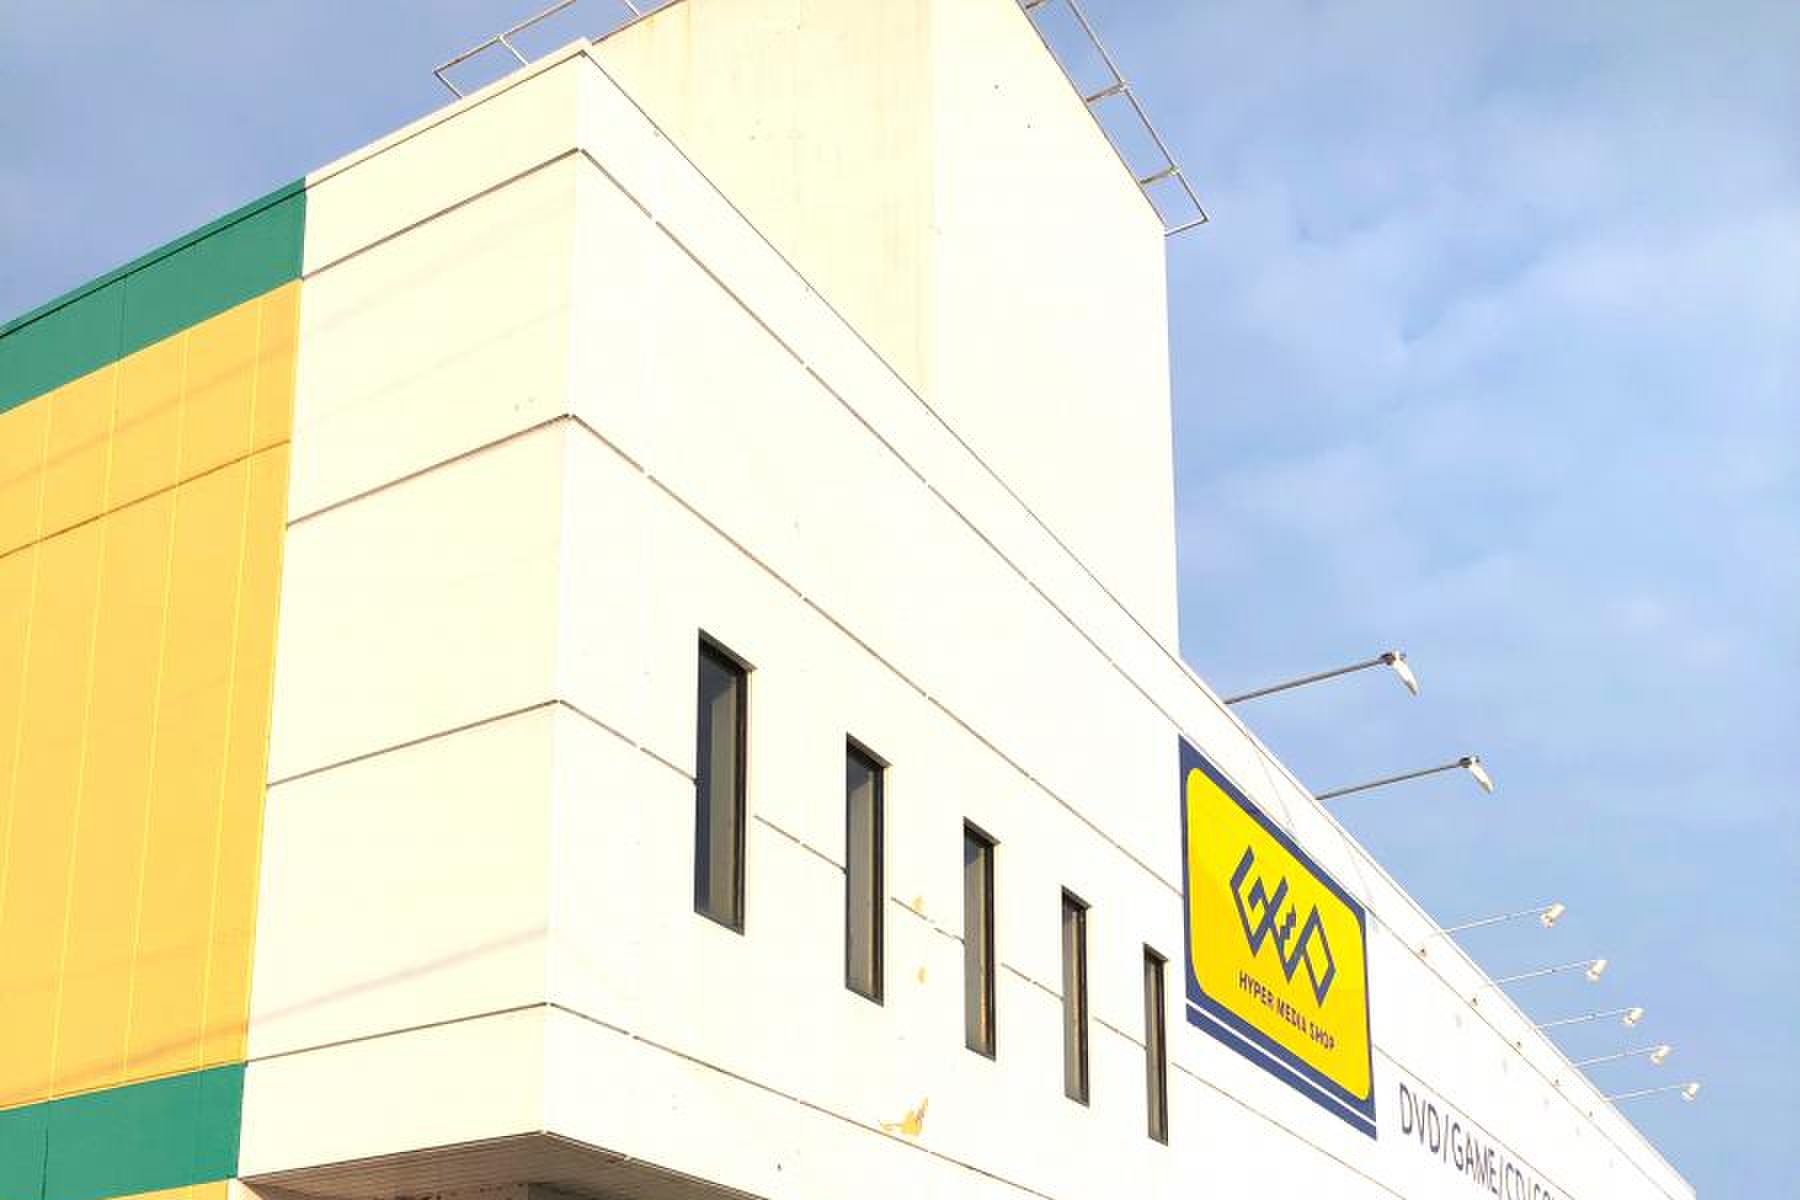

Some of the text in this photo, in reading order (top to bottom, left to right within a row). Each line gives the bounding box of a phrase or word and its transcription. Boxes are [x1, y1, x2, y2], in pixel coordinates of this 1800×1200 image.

[1239, 970, 1335, 1050] HYPER MEDIA SHOP
